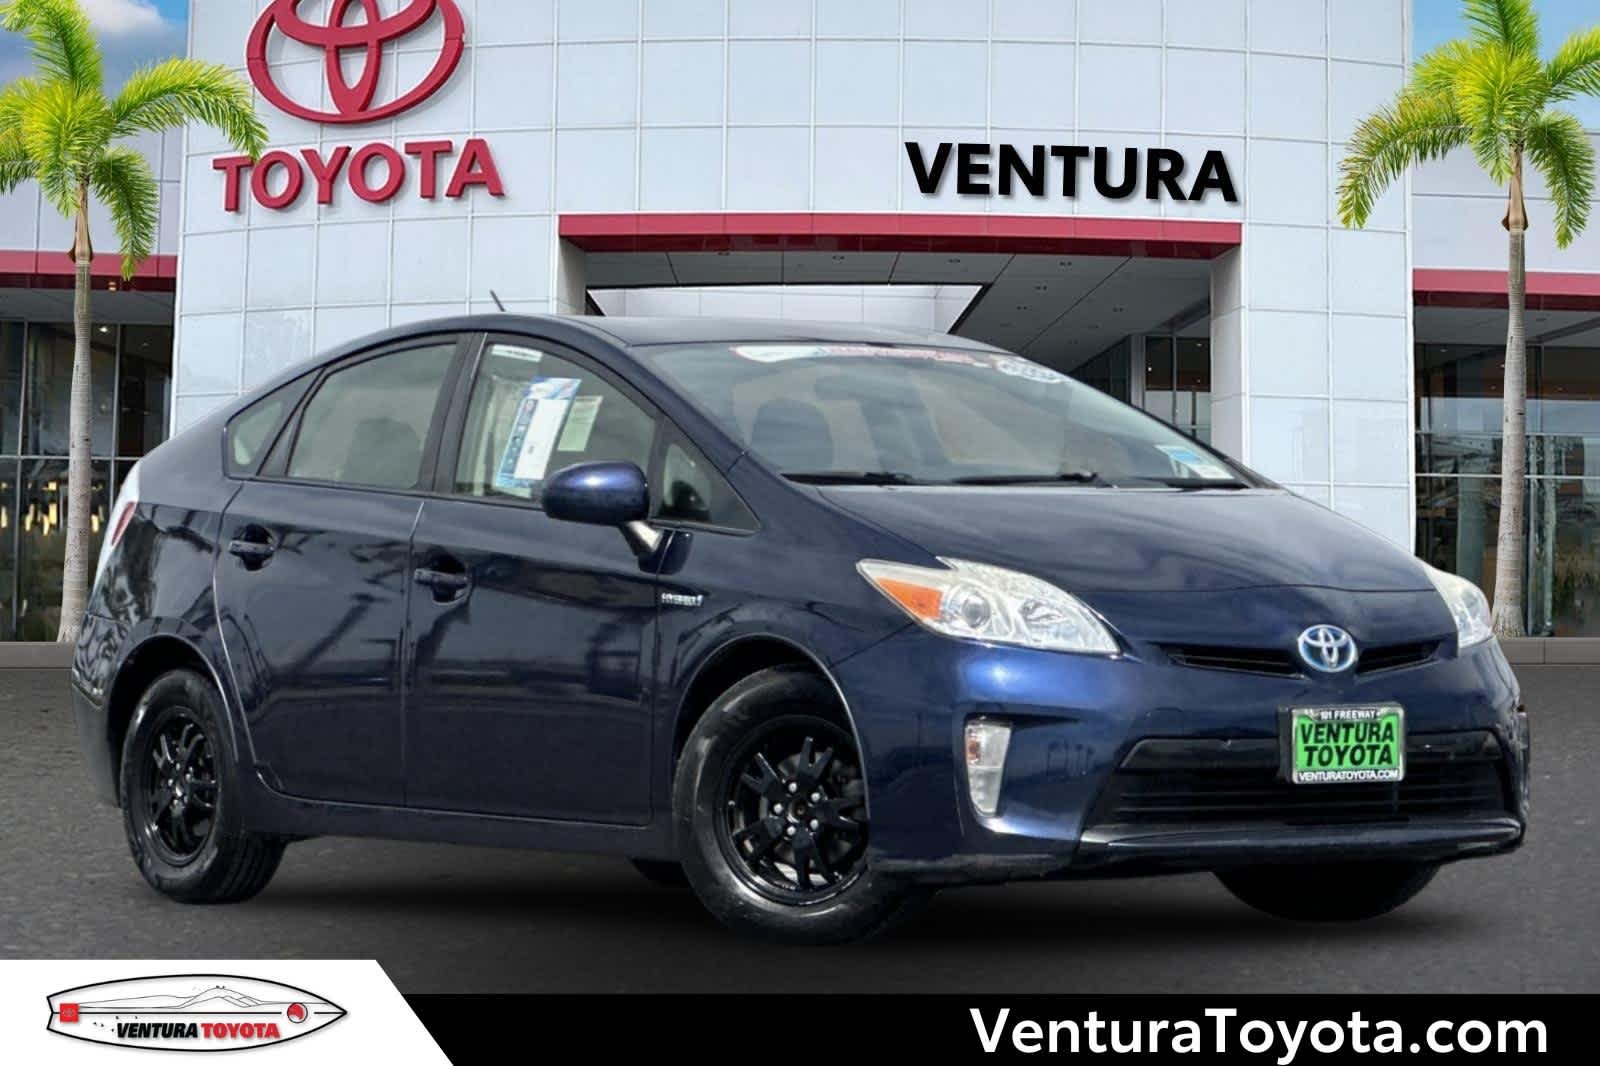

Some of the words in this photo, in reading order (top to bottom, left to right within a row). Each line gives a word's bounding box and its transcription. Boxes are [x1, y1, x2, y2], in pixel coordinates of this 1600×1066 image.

[213, 138, 505, 212] TOYOTA
[904, 142, 1238, 203] VENTURA
[1334, 709, 1376, 720] FREEWAY
[1301, 722, 1394, 744] VENTURA
[1304, 744, 1393, 767] TOYOTA
[1299, 770, 1398, 781] VENTURATOYOTA.COM
